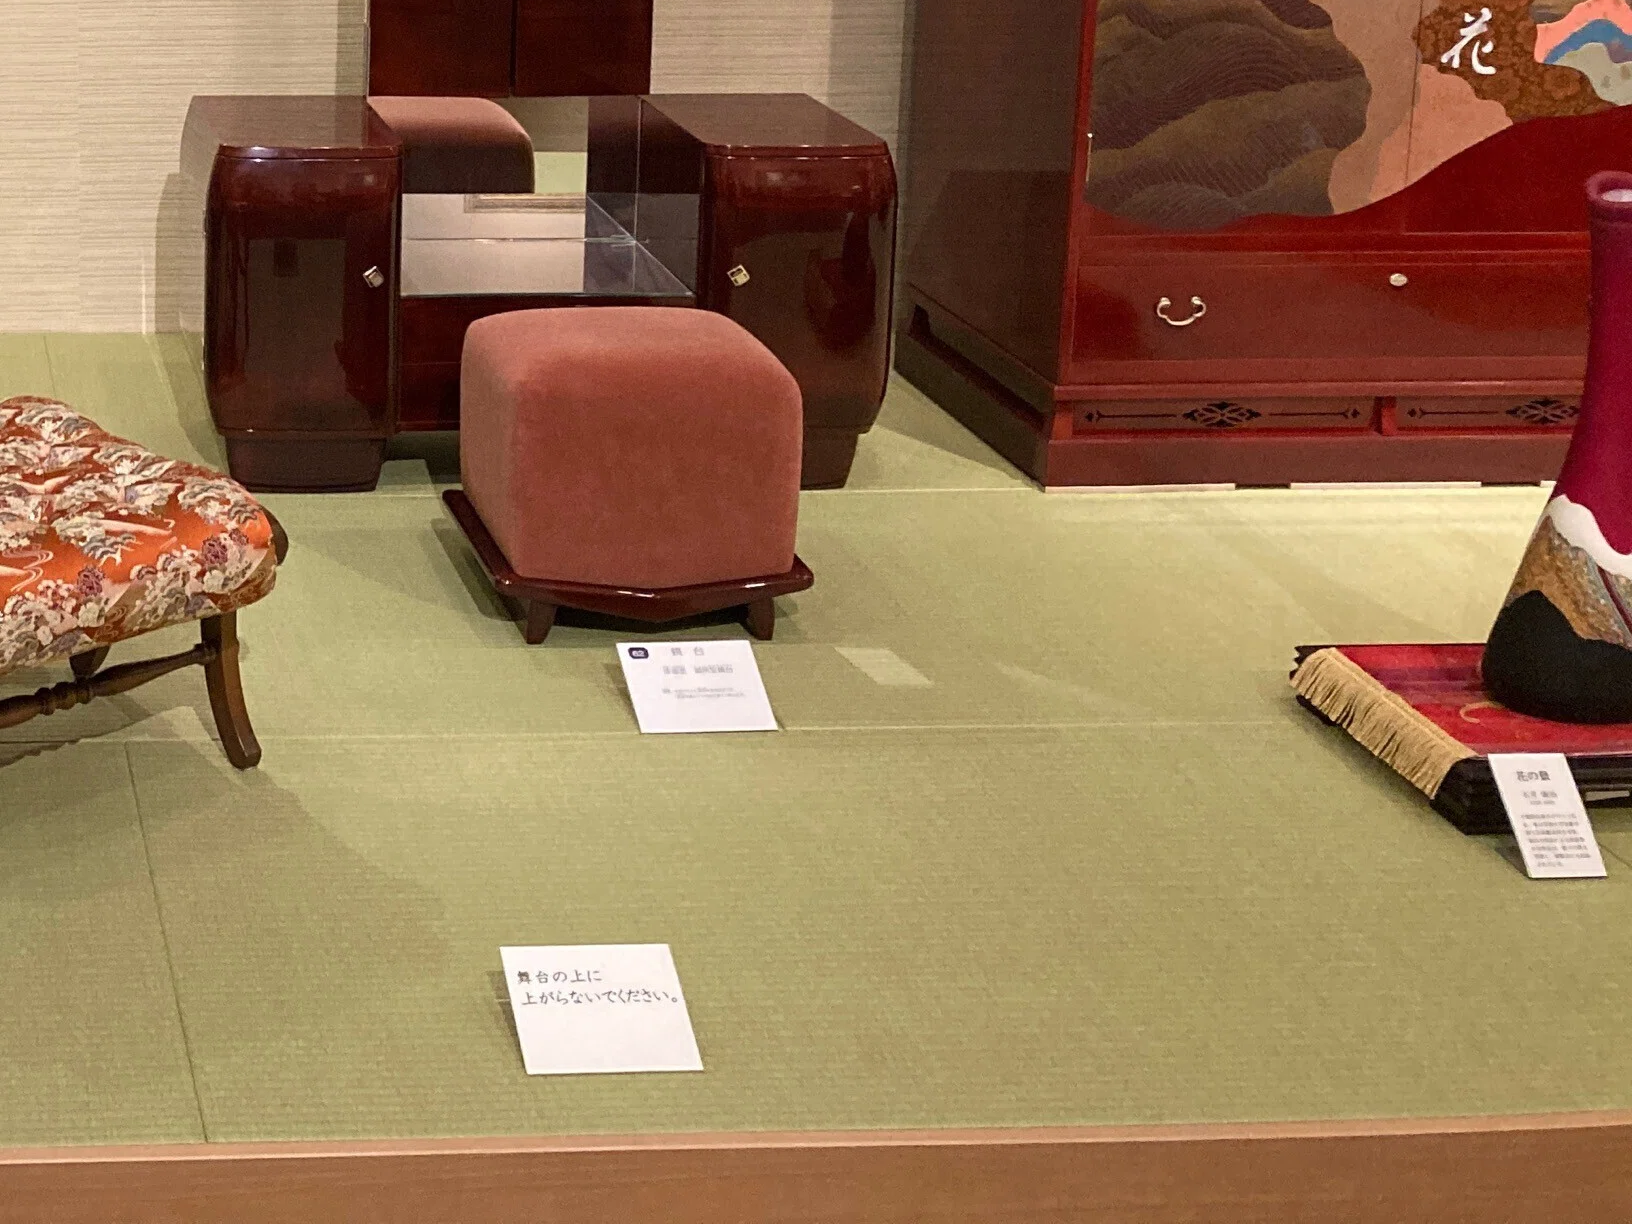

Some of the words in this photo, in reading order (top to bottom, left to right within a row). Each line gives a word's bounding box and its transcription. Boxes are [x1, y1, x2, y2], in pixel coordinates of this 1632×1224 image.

[517, 969, 603, 984] 舞台の上に
[521, 988, 678, 1006] 上がらないでください。
